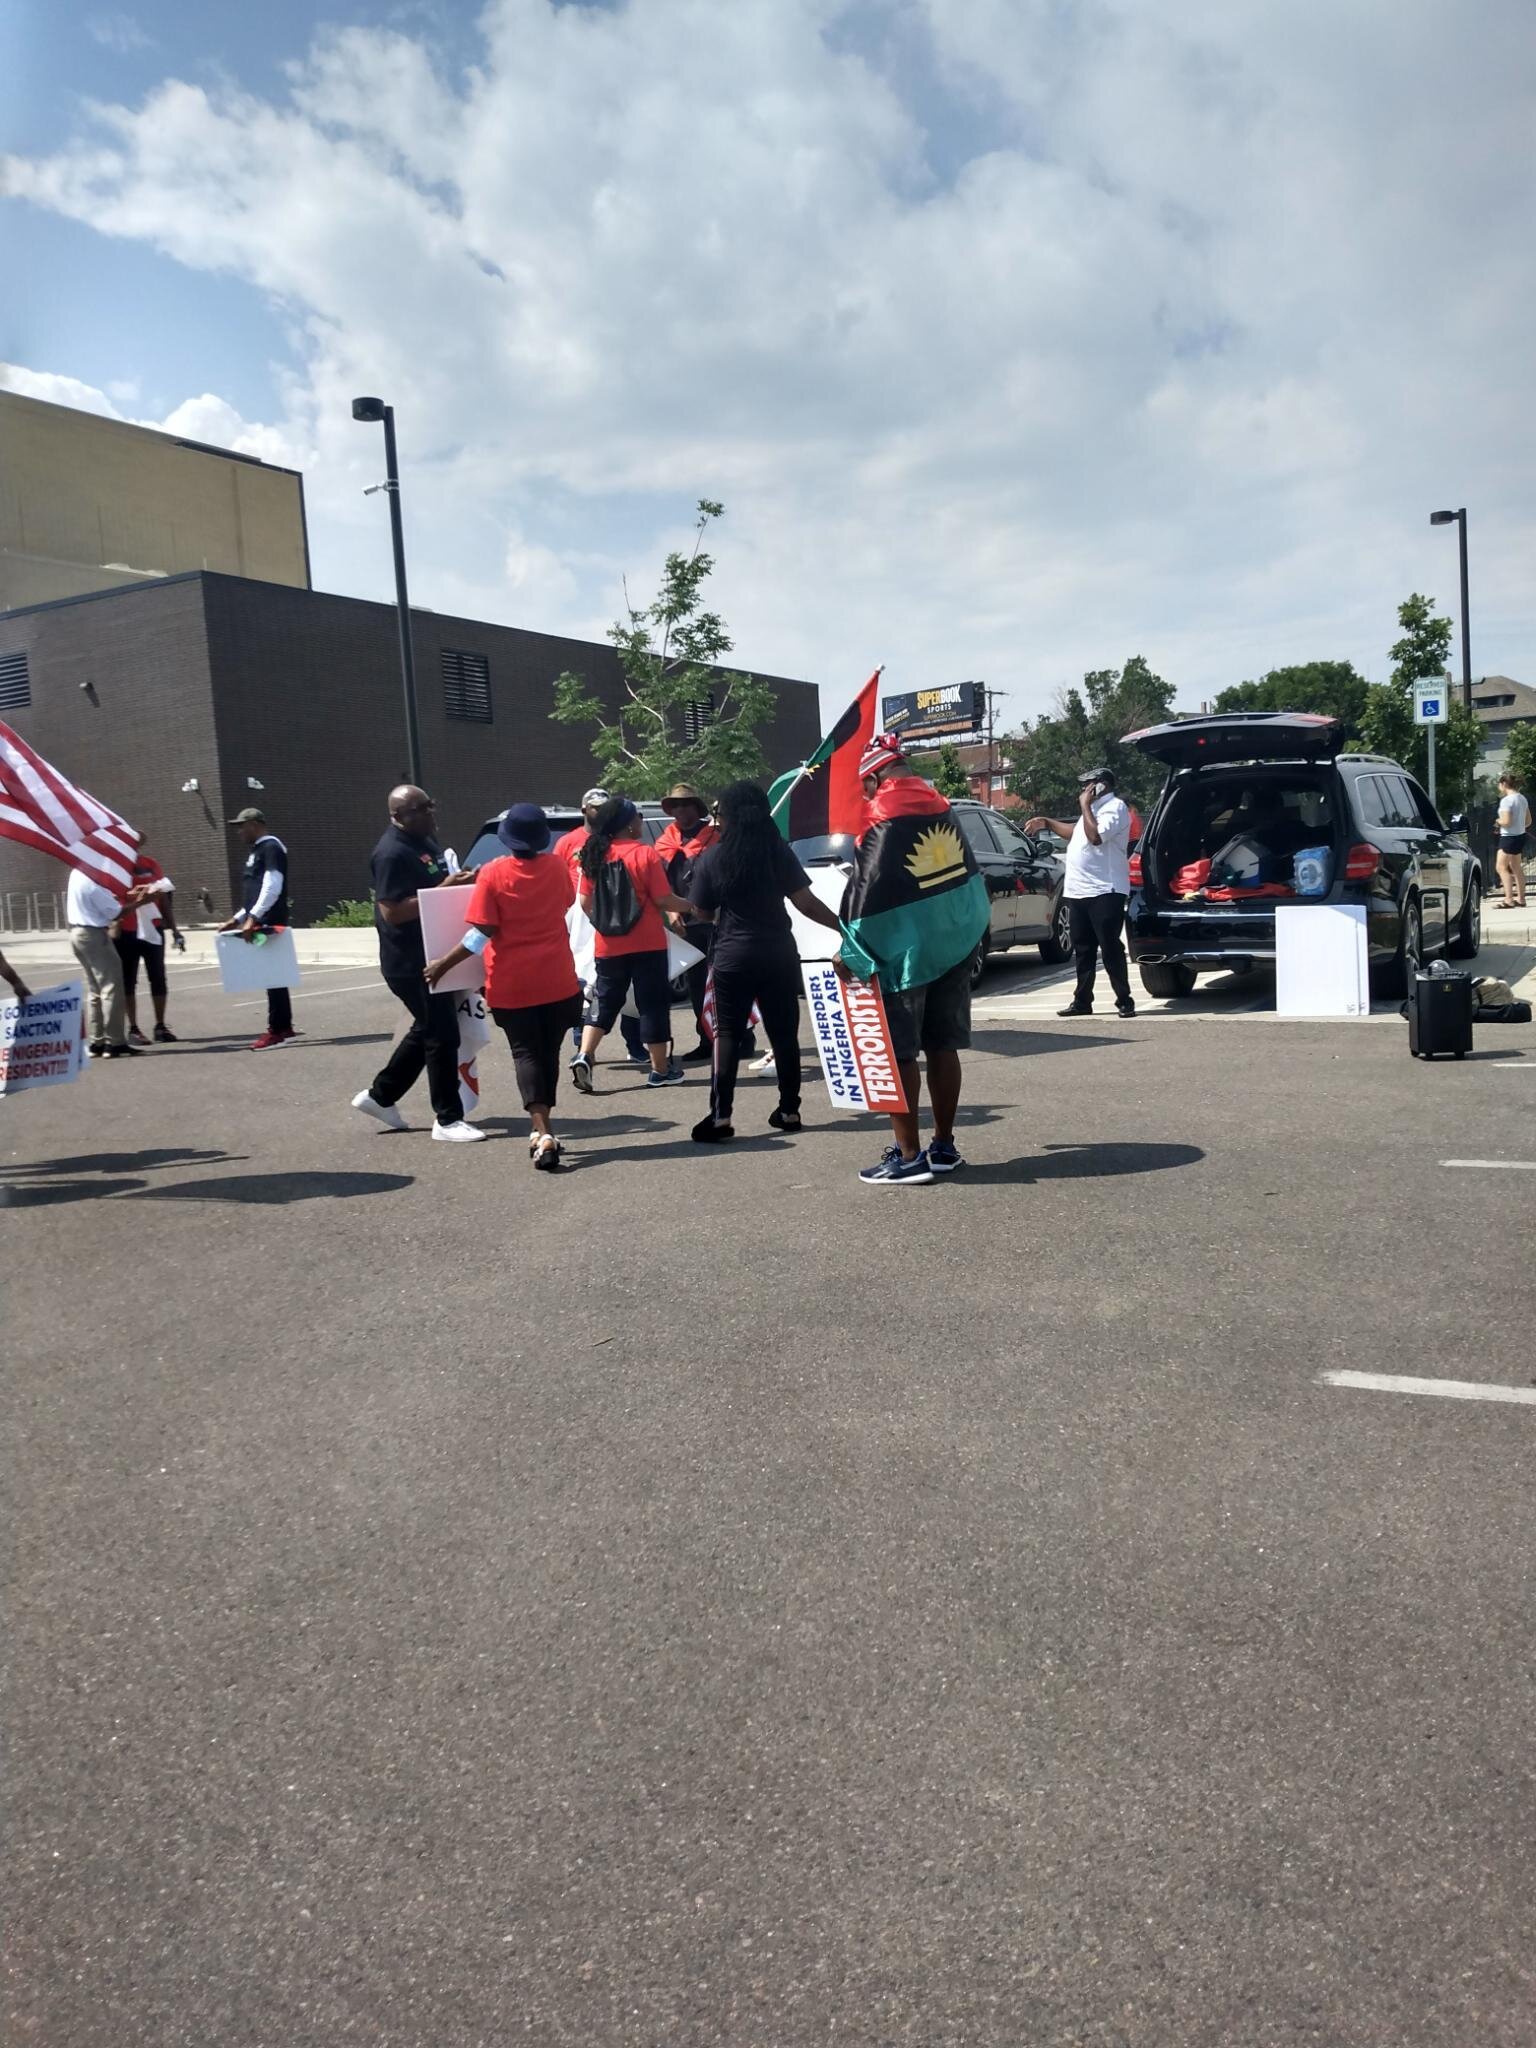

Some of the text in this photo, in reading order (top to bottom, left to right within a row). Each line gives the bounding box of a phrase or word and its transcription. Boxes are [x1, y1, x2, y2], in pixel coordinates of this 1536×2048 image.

[917, 685, 961, 710] SUPERBOOK
[927, 703, 952, 713] SPORTS
[4, 997, 79, 1019] GOVERNMENT
[5, 1020, 62, 1040] SANCTION
[809, 976, 845, 1096] CATTLE HERDERS
[823, 970, 864, 1102] IN NIGERIA ARE
[12, 1040, 72, 1061] NIGERIAN
[0, 1059, 69, 1080] RESIDENT!!!
